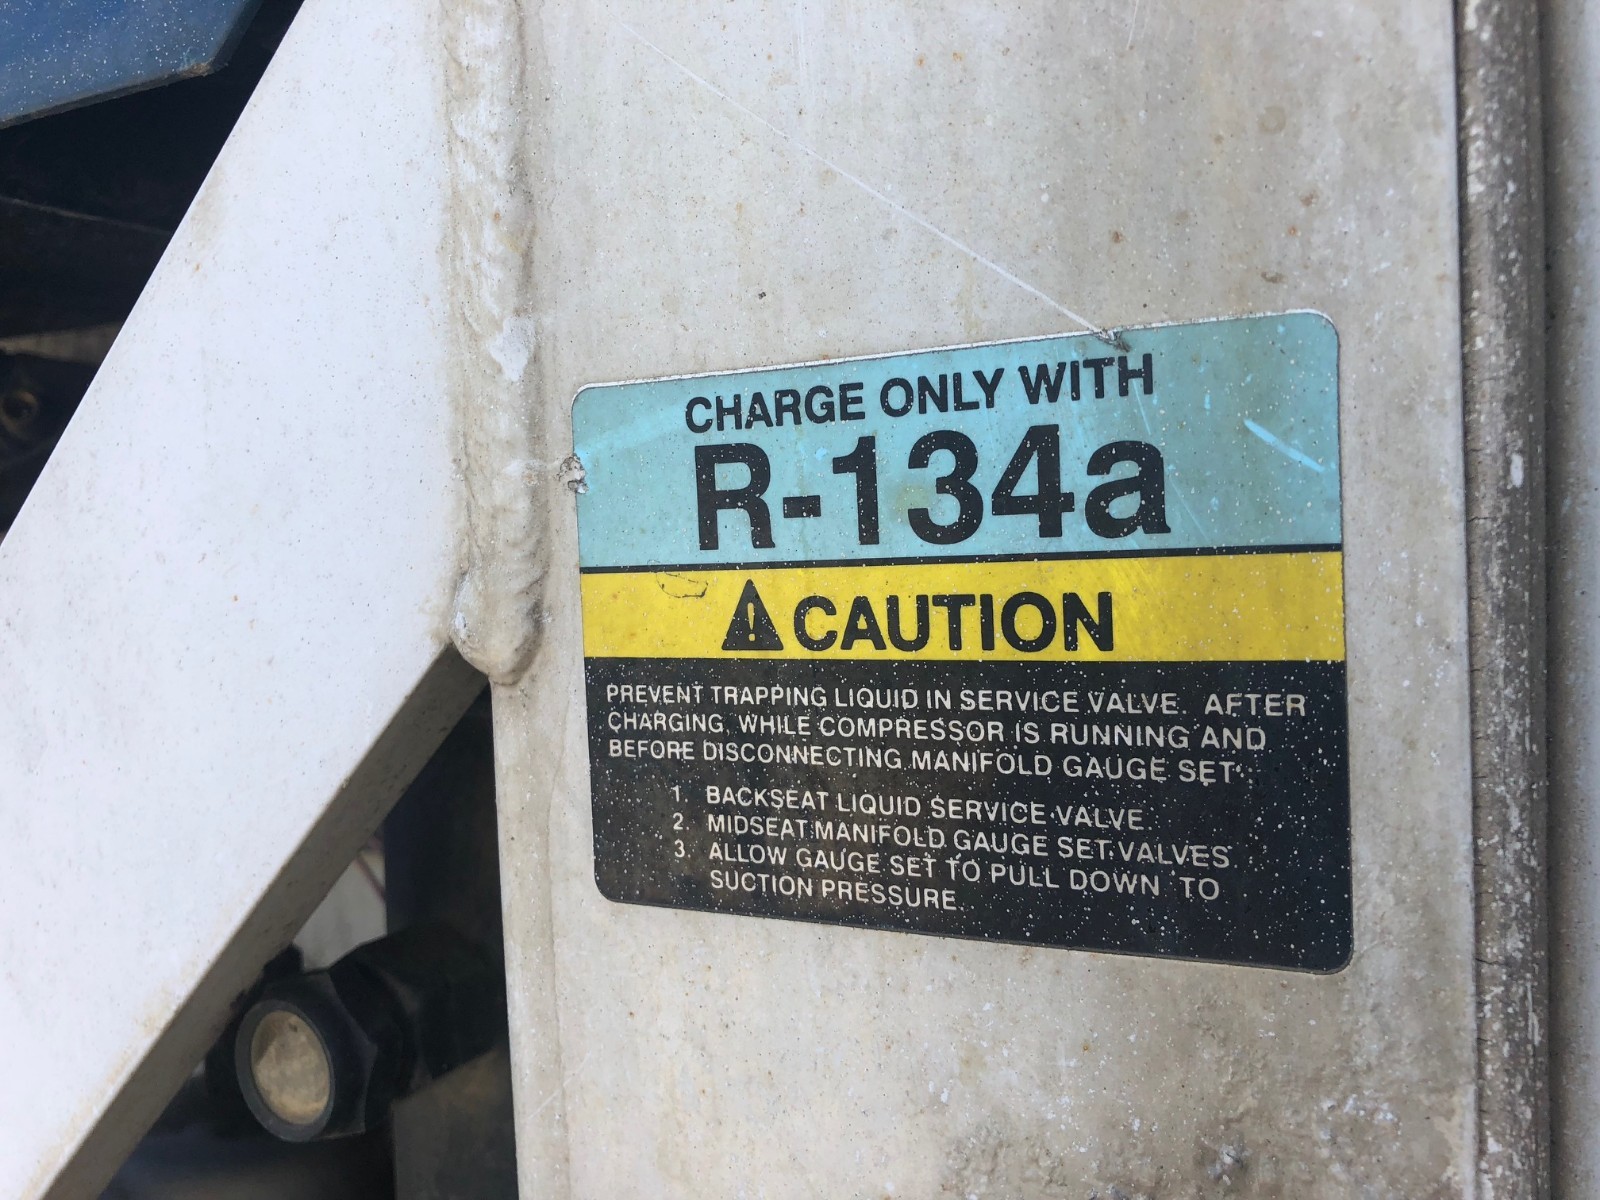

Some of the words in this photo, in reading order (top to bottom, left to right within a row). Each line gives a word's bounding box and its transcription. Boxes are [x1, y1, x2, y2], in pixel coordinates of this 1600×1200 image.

[685, 383, 866, 434] CHARGE
[880, 367, 1004, 418] ONLY
[1018, 352, 1154, 404] WITH
[694, 424, 1172, 551] R-134a
[794, 591, 1114, 653] CAUTION
[606, 684, 703, 704] PREVENT
[710, 686, 827, 708] TRAPPING
[835, 688, 918, 709] LIQUID
[927, 689, 951, 710] IN
[960, 689, 1078, 713] SERVICE
[1204, 693, 1306, 717] AFTER
[739, 714, 811, 736] WHILE
[819, 717, 1003, 742] COMPRESSOR
[1015, 722, 1038, 744] IS
[1051, 722, 1189, 748] RUNNING
[1201, 726, 1266, 751] AND
[609, 740, 694, 760] BEFORE
[702, 740, 902, 769] DISCONNECTING
[911, 749, 1052, 776] MANIFOLD
[1062, 755, 1168, 781] GAUGE
[706, 785, 828, 811] BACKSEAT
[836, 792, 920, 818] LIQUID
[930, 797, 1047, 826] SERVICE
[707, 813, 807, 840] MIDSEAT
[814, 819, 945, 849] MANIFOLD
[953, 829, 1049, 857] GAUGE
[1057, 836, 1112, 861] SET
[709, 841, 786, 866] ALLOW
[796, 847, 881, 875] GAUGE
[889, 855, 937, 878] SET
[945, 858, 981, 882] TO
[991, 863, 1060, 889] PULL
[1069, 868, 1160, 897] DOWN
[1179, 876, 1220, 901] TO
[710, 868, 813, 896] SUCTION
